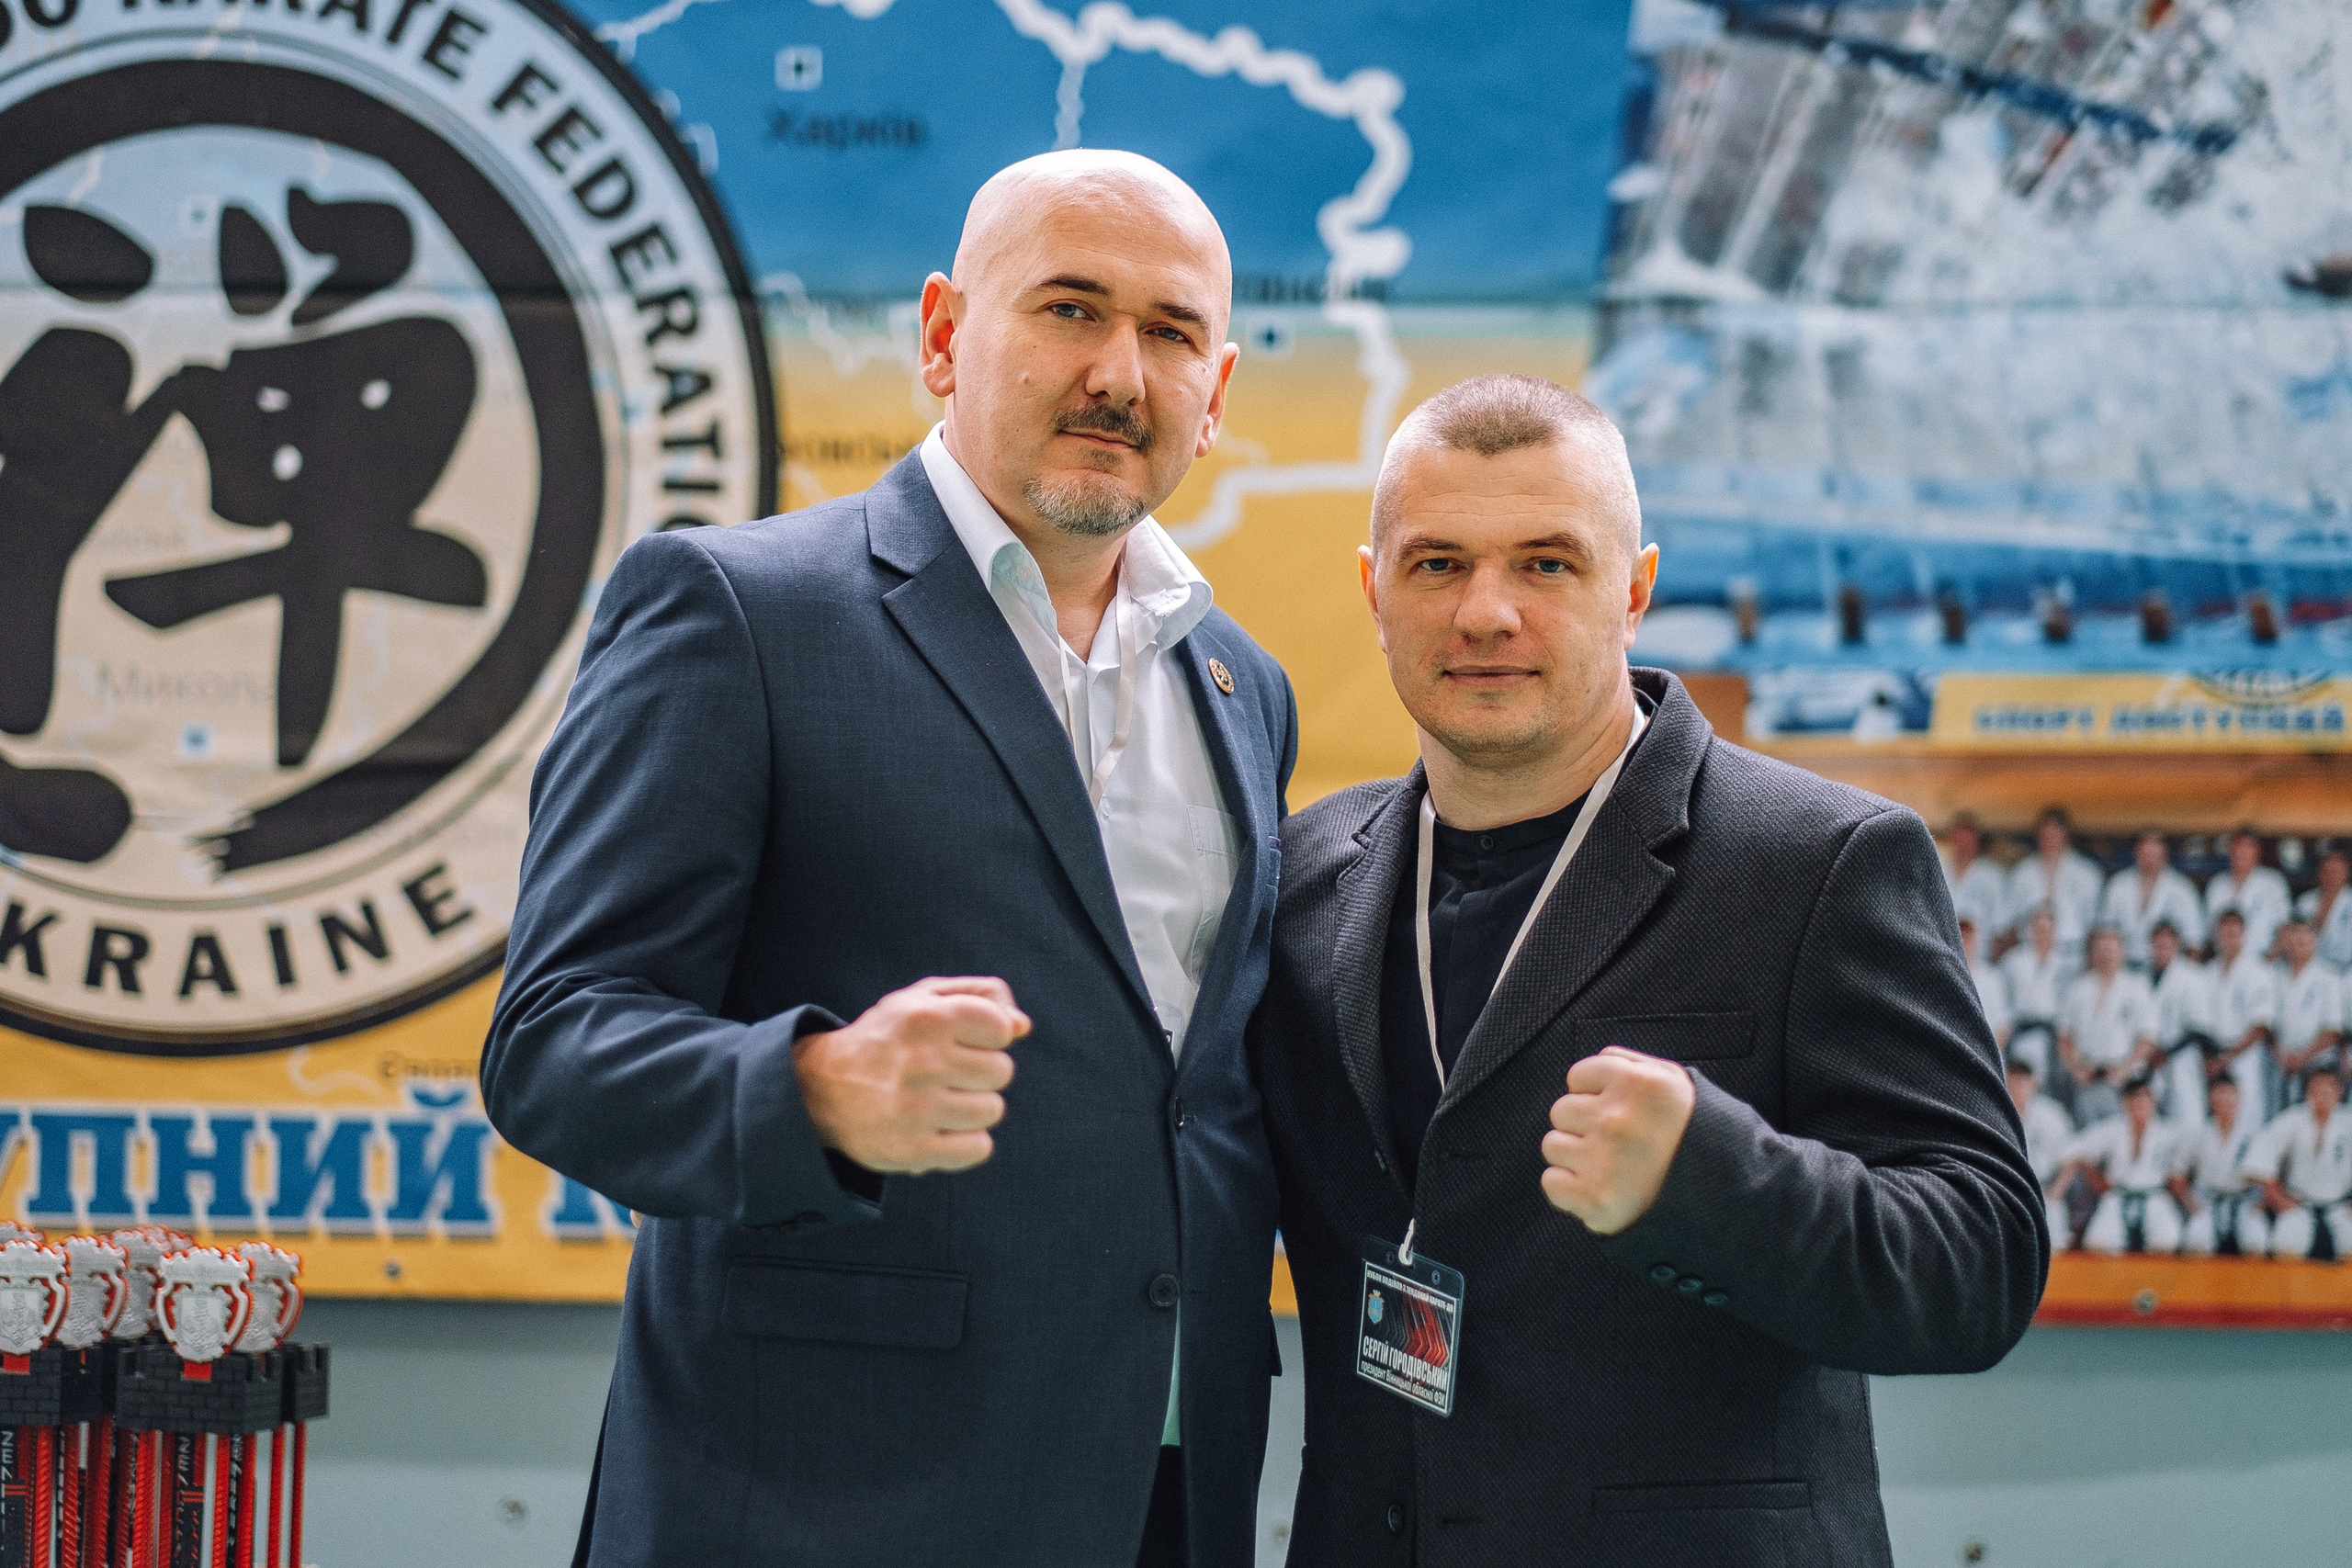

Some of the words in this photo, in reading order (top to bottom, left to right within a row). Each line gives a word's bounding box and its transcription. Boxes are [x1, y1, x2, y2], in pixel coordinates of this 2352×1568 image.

[492, 61, 722, 533] FEDERATI
[0, 860, 475, 999] KRAINE
[1361, 1360, 1386, 1380] президент
[1434, 1391, 1445, 1407] ФЗК
[1363, 1335, 1389, 1365] СЕРГІЙ
[1388, 1347, 1448, 1392] ГОРОДІВСЬКИЙ
